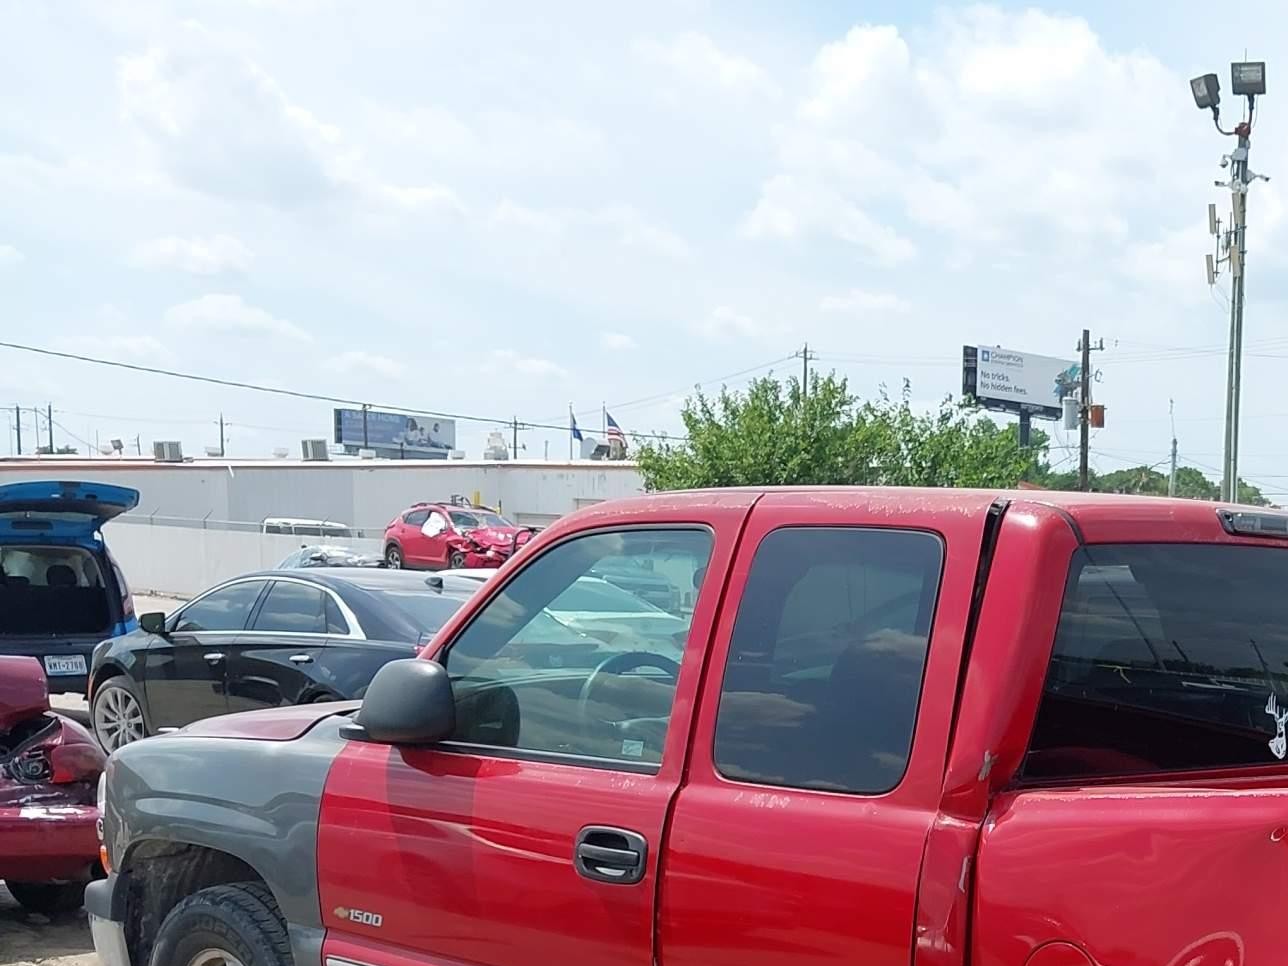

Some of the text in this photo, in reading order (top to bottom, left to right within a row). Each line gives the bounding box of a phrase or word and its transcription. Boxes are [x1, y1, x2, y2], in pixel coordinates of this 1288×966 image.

[980, 370, 990, 379] No
[980, 380, 990, 391] No
[991, 381, 1013, 393] hidden
[350, 909, 383, 927] 1500
